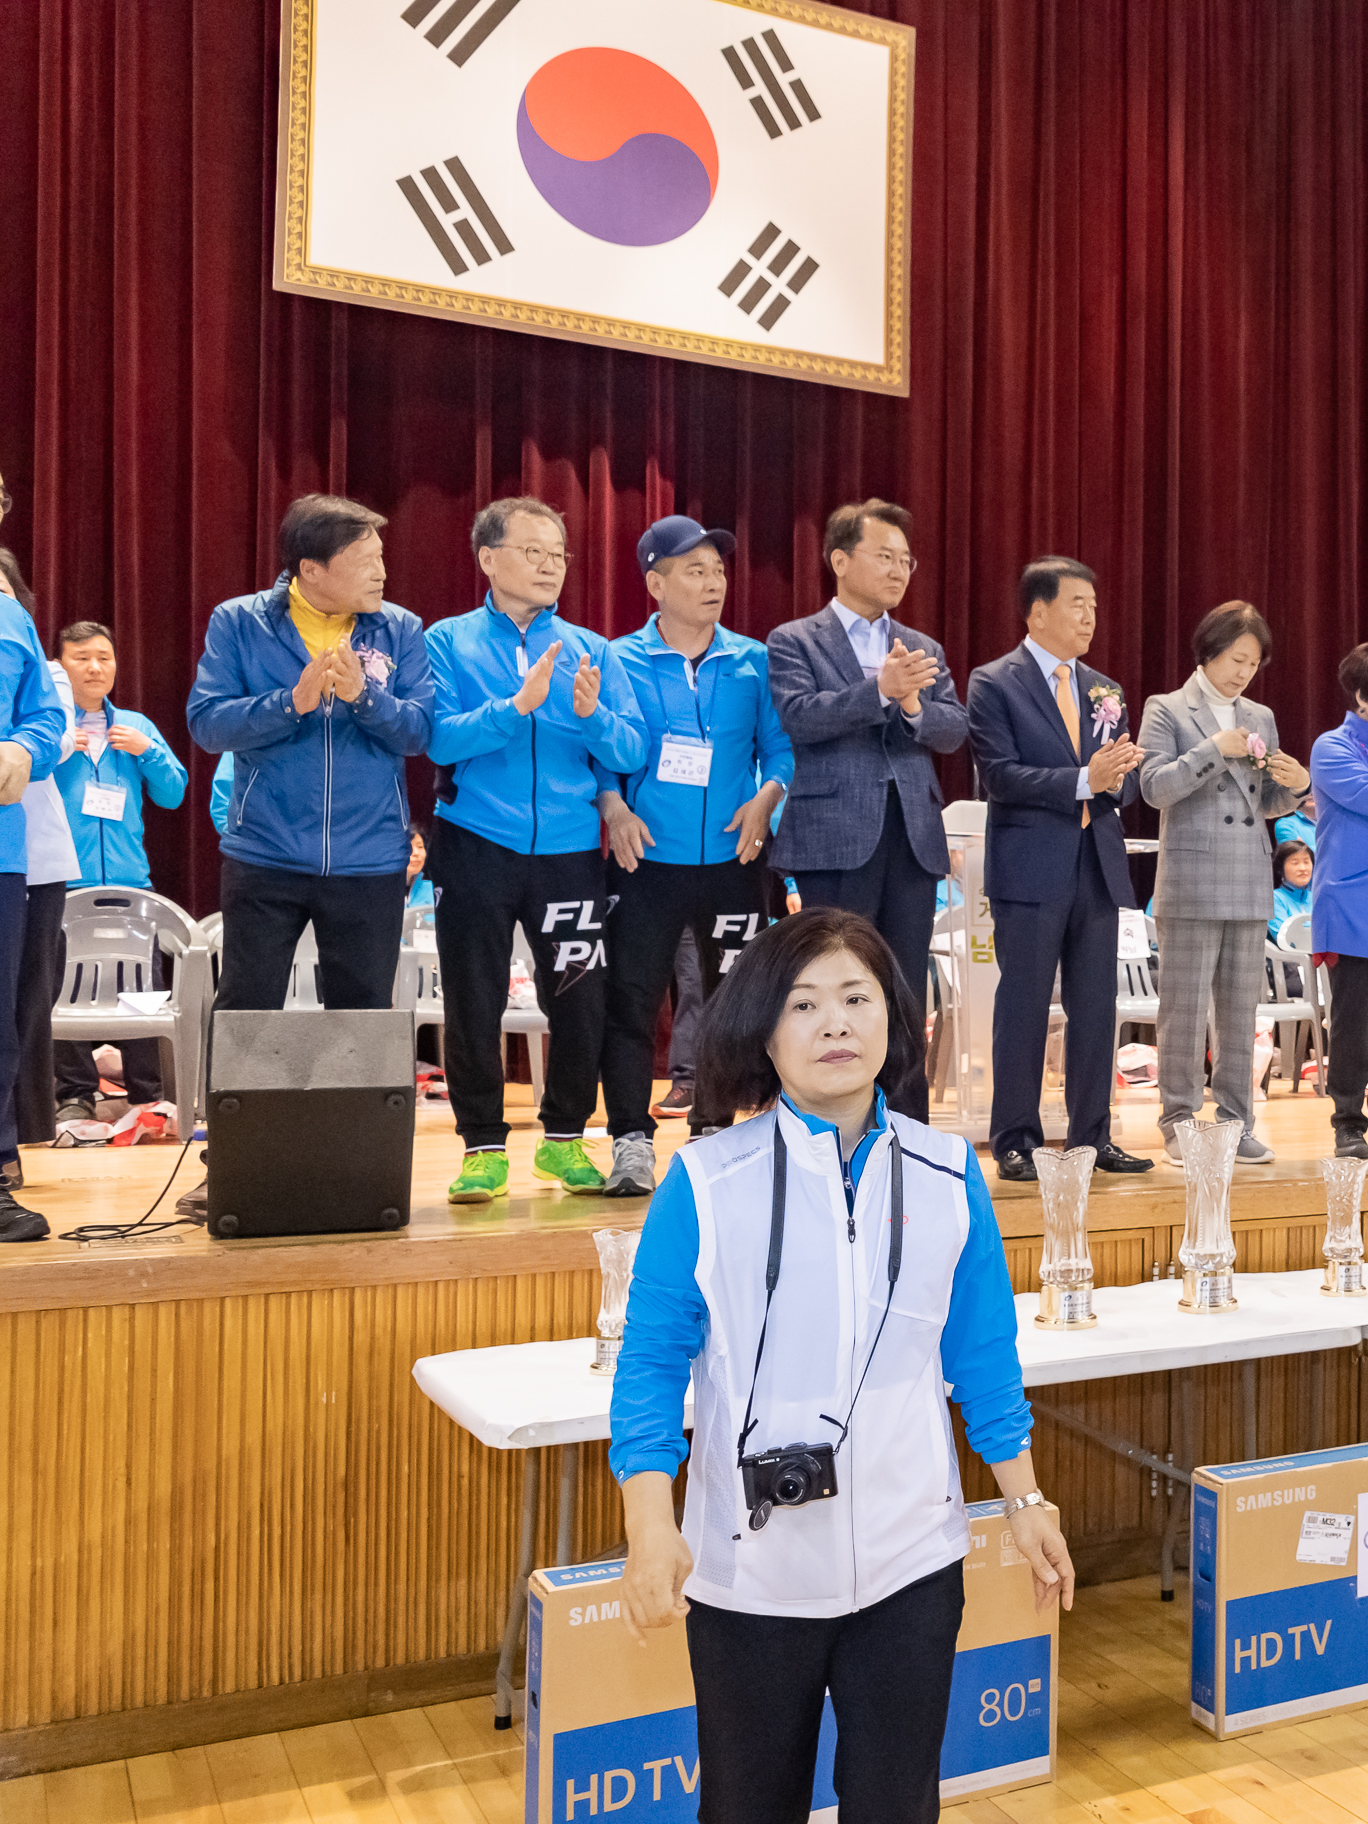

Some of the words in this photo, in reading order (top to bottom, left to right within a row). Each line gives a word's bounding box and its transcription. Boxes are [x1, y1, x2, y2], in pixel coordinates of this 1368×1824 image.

[1220, 1461, 1295, 1476] SAMSUNG
[1236, 1485, 1317, 1513] SAMSUNG
[560, 1565, 625, 1581] SAMS
[1234, 1631, 1283, 1674] HD
[1287, 1619, 1333, 1662] TV
[978, 1682, 1027, 1728] 80
[1027, 1707, 1042, 1717] cm
[566, 1768, 637, 1822] HD
[643, 1755, 700, 1802] TV
